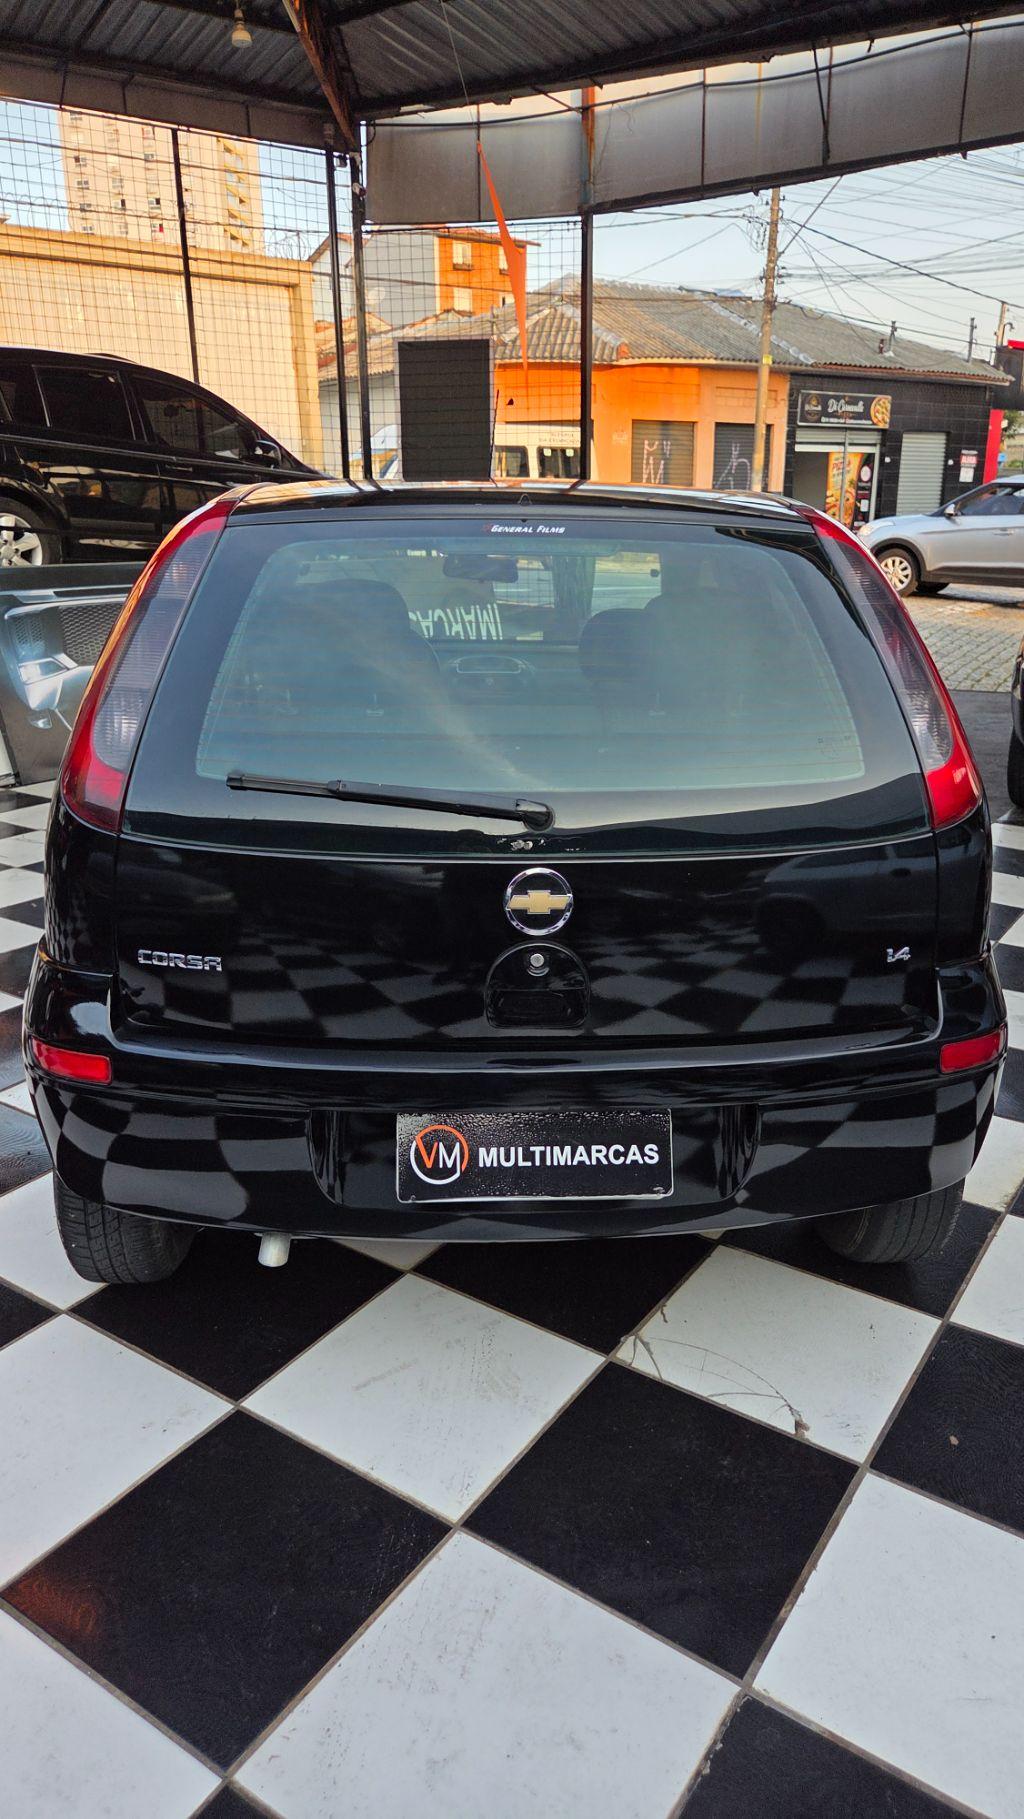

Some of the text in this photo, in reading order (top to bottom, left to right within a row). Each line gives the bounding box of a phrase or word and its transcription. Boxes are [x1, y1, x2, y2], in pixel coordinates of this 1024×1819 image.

[491, 525, 565, 534] GENERAL FILMS
[138, 949, 222, 971] CORSA
[478, 1144, 660, 1168] MULTIMARCAS
